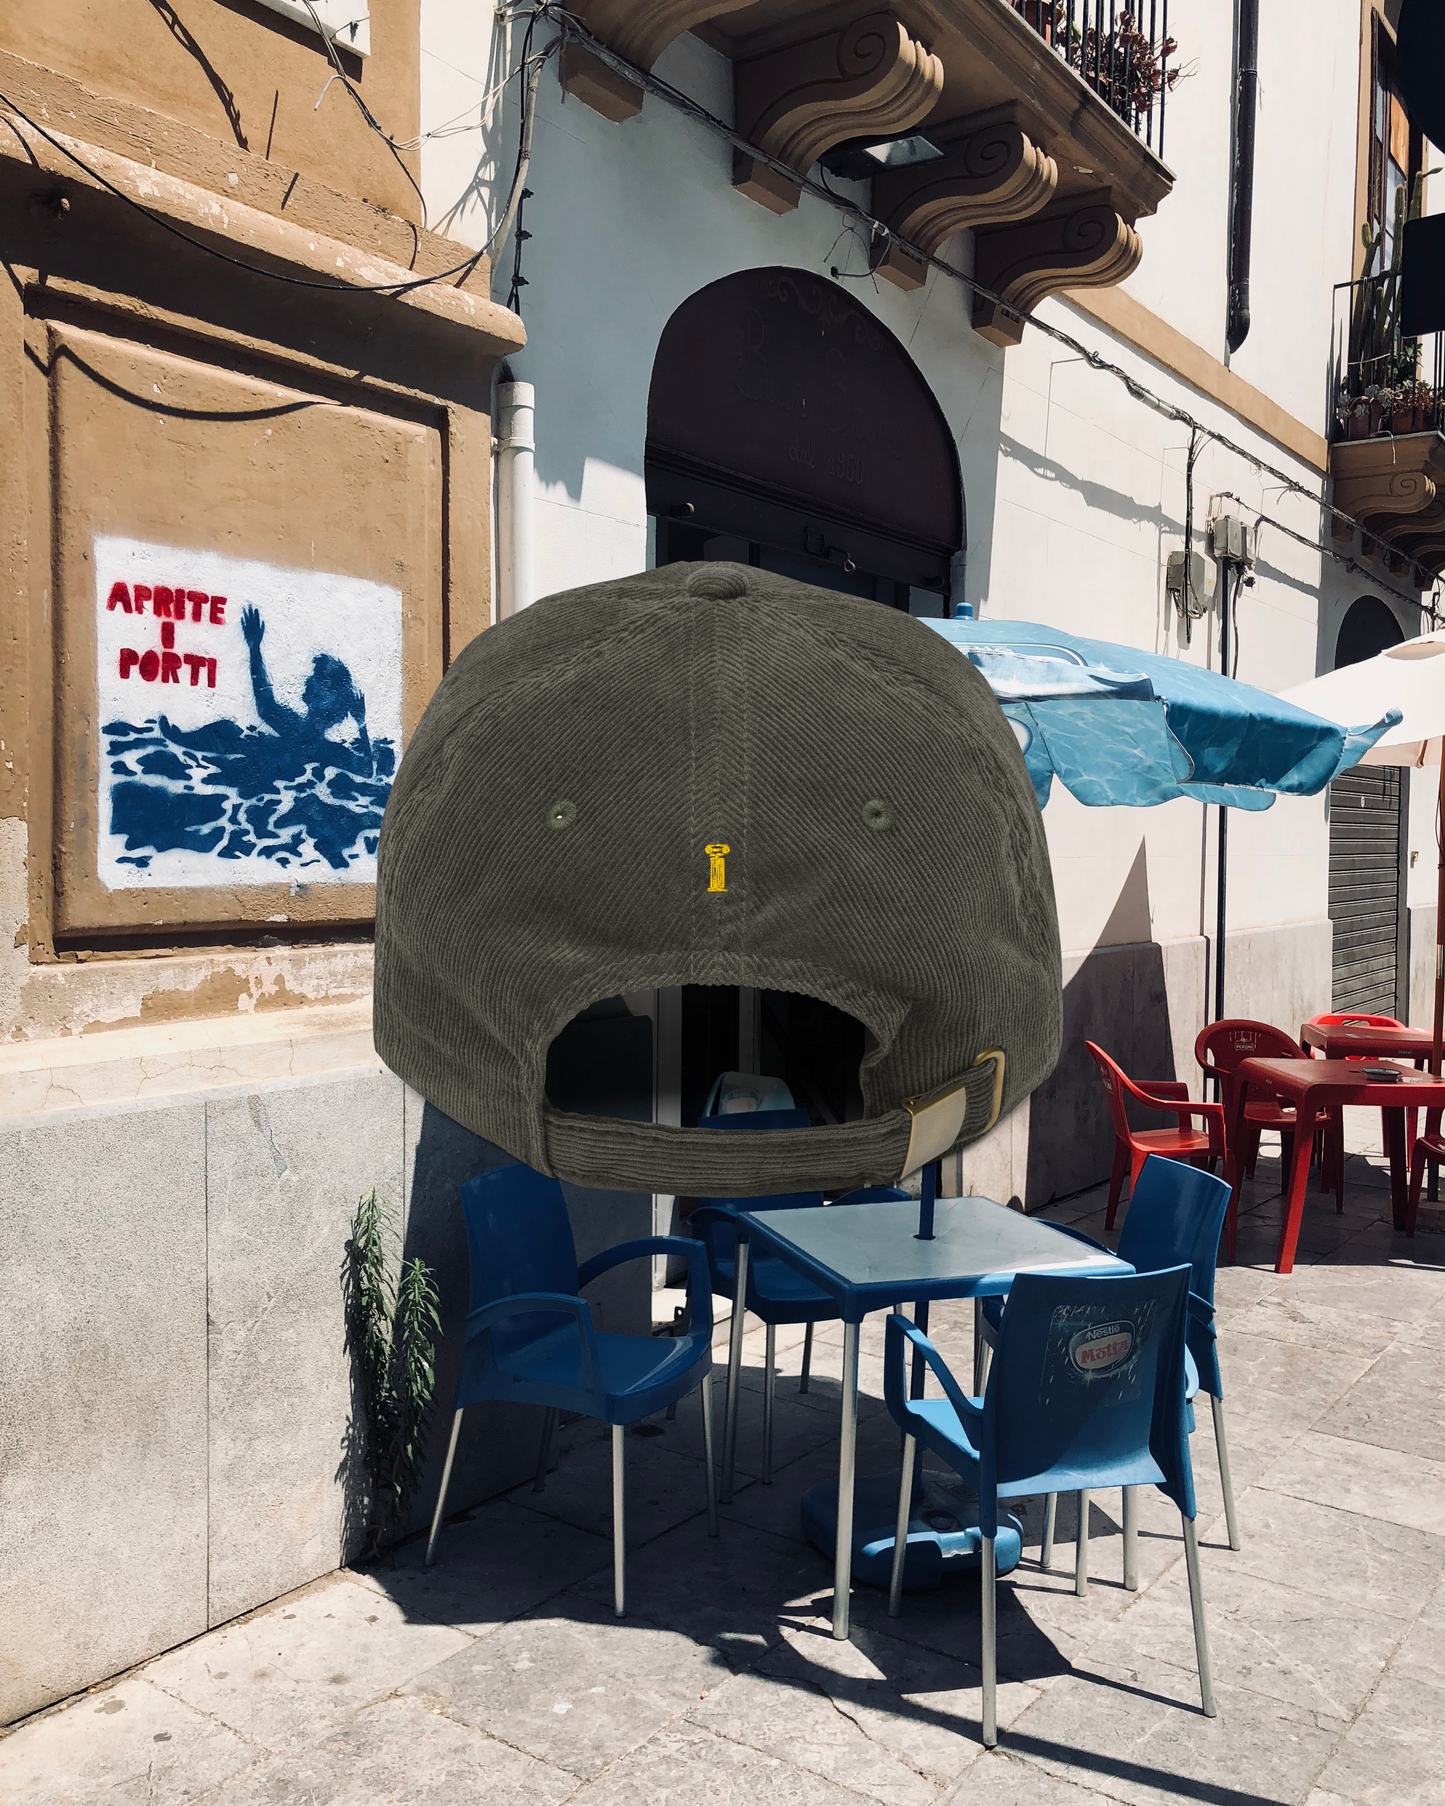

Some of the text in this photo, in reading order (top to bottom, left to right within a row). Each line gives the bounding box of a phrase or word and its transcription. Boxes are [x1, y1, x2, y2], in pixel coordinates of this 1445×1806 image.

[827, 449, 865, 485] 1950
[106, 582, 227, 625] APRITE
[161, 621, 175, 649] I
[119, 648, 217, 688] PORTI
[1080, 1339, 1129, 1364] Motta
